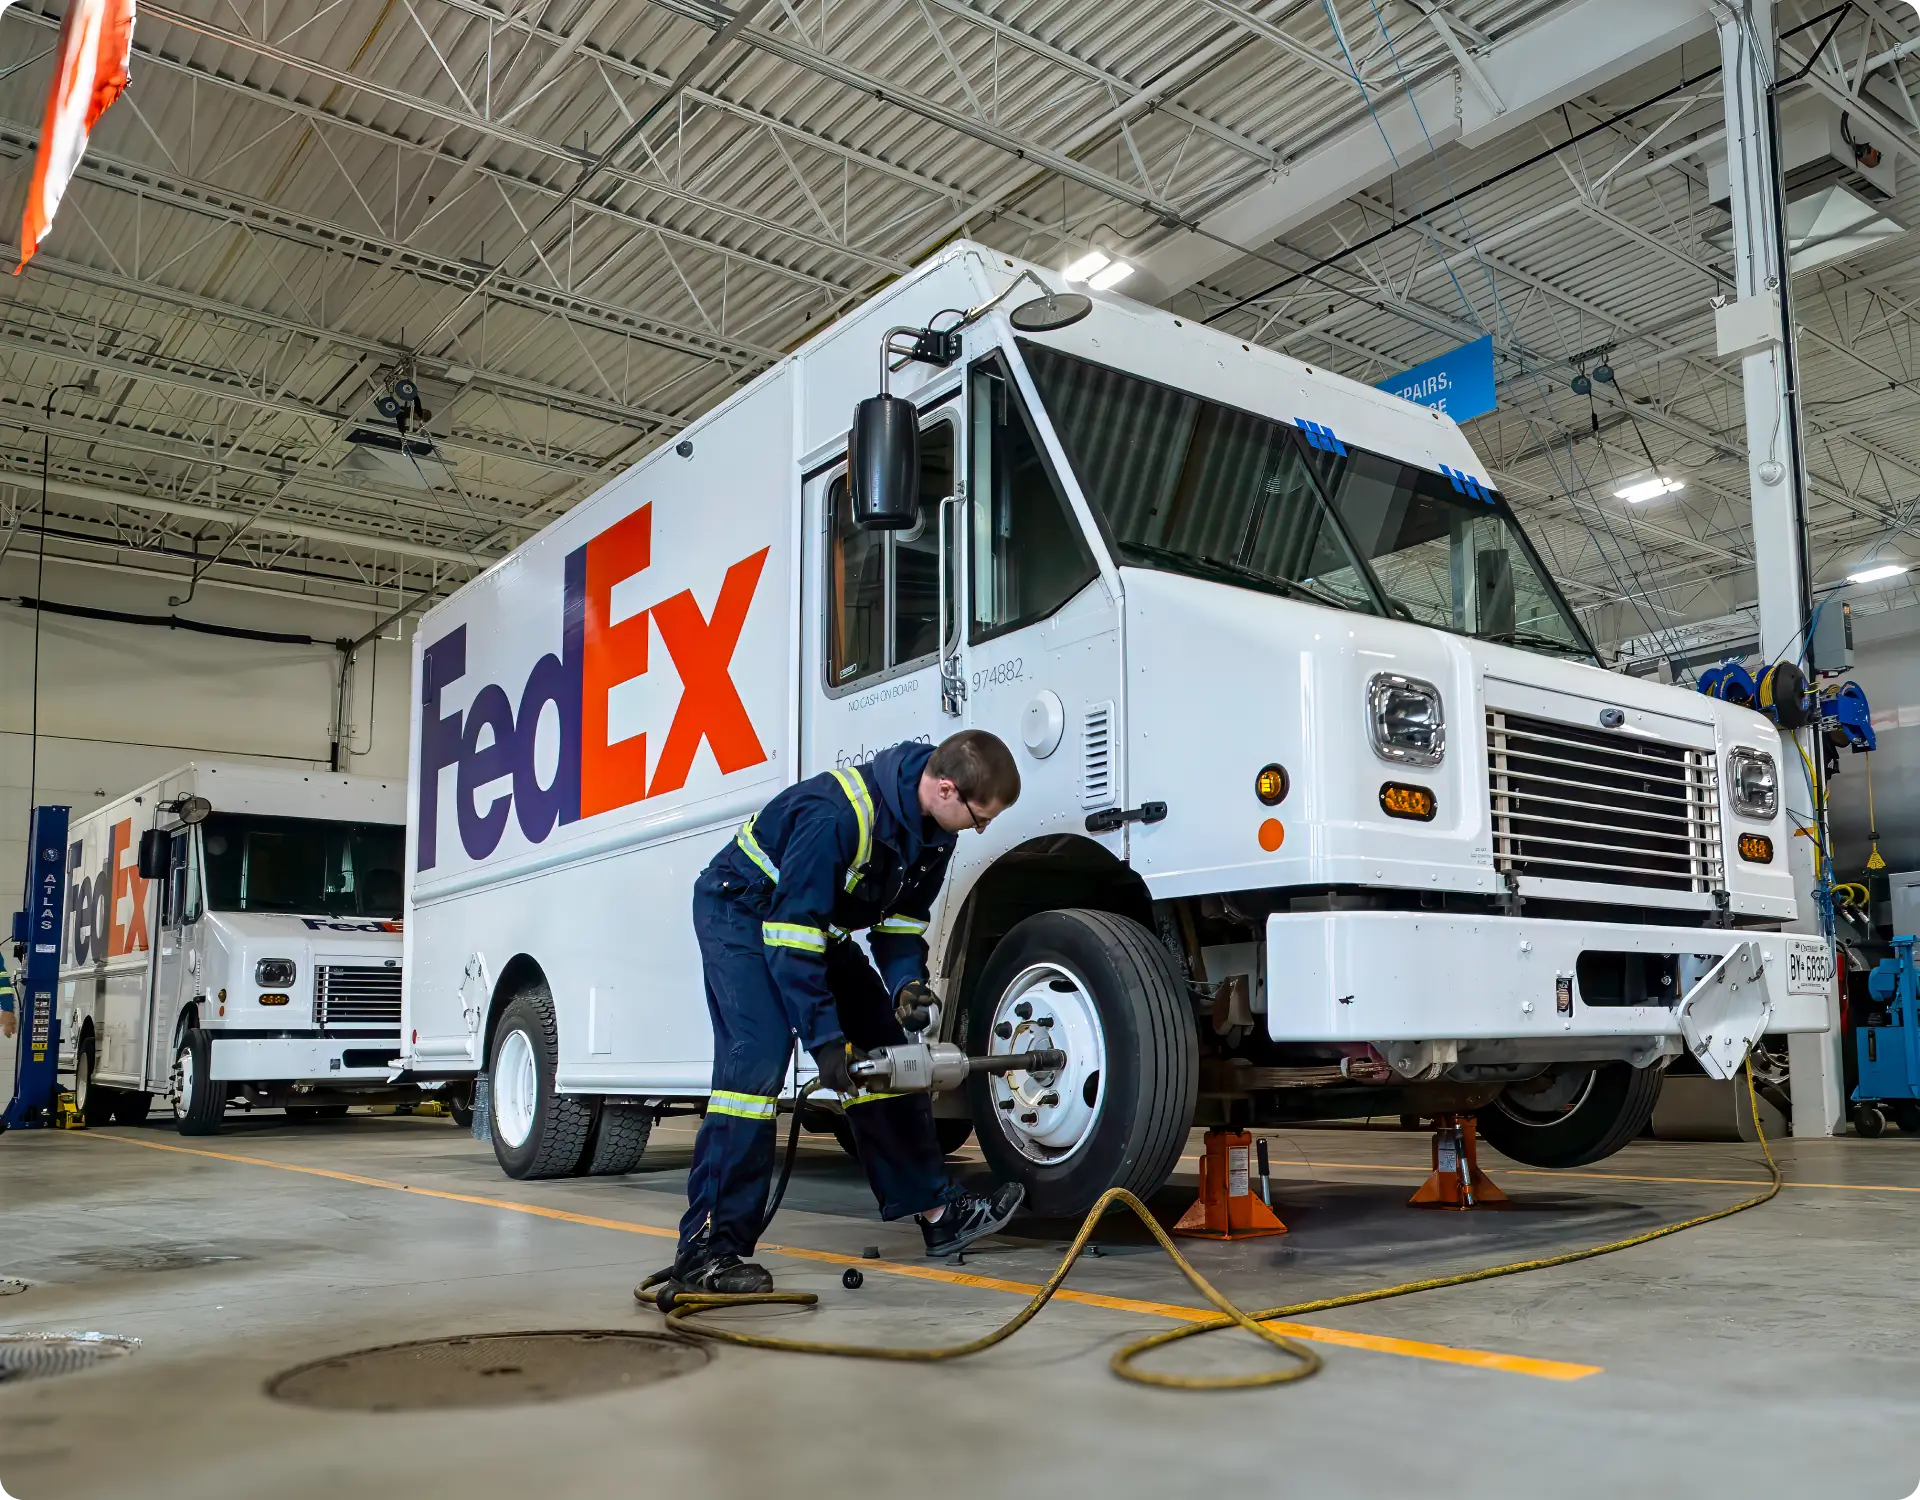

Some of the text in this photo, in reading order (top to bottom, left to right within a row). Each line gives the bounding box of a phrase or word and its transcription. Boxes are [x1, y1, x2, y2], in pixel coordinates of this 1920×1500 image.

[417, 500, 771, 873] FedEx
[972, 657, 1023, 692] 974882
[848, 679, 919, 712] NO CASH ON BOARD
[41, 873, 57, 930] ATLAS
[61, 818, 150, 967] FedEx
[300, 918, 403, 933] FedE
[1790, 953, 1801, 981] BY
